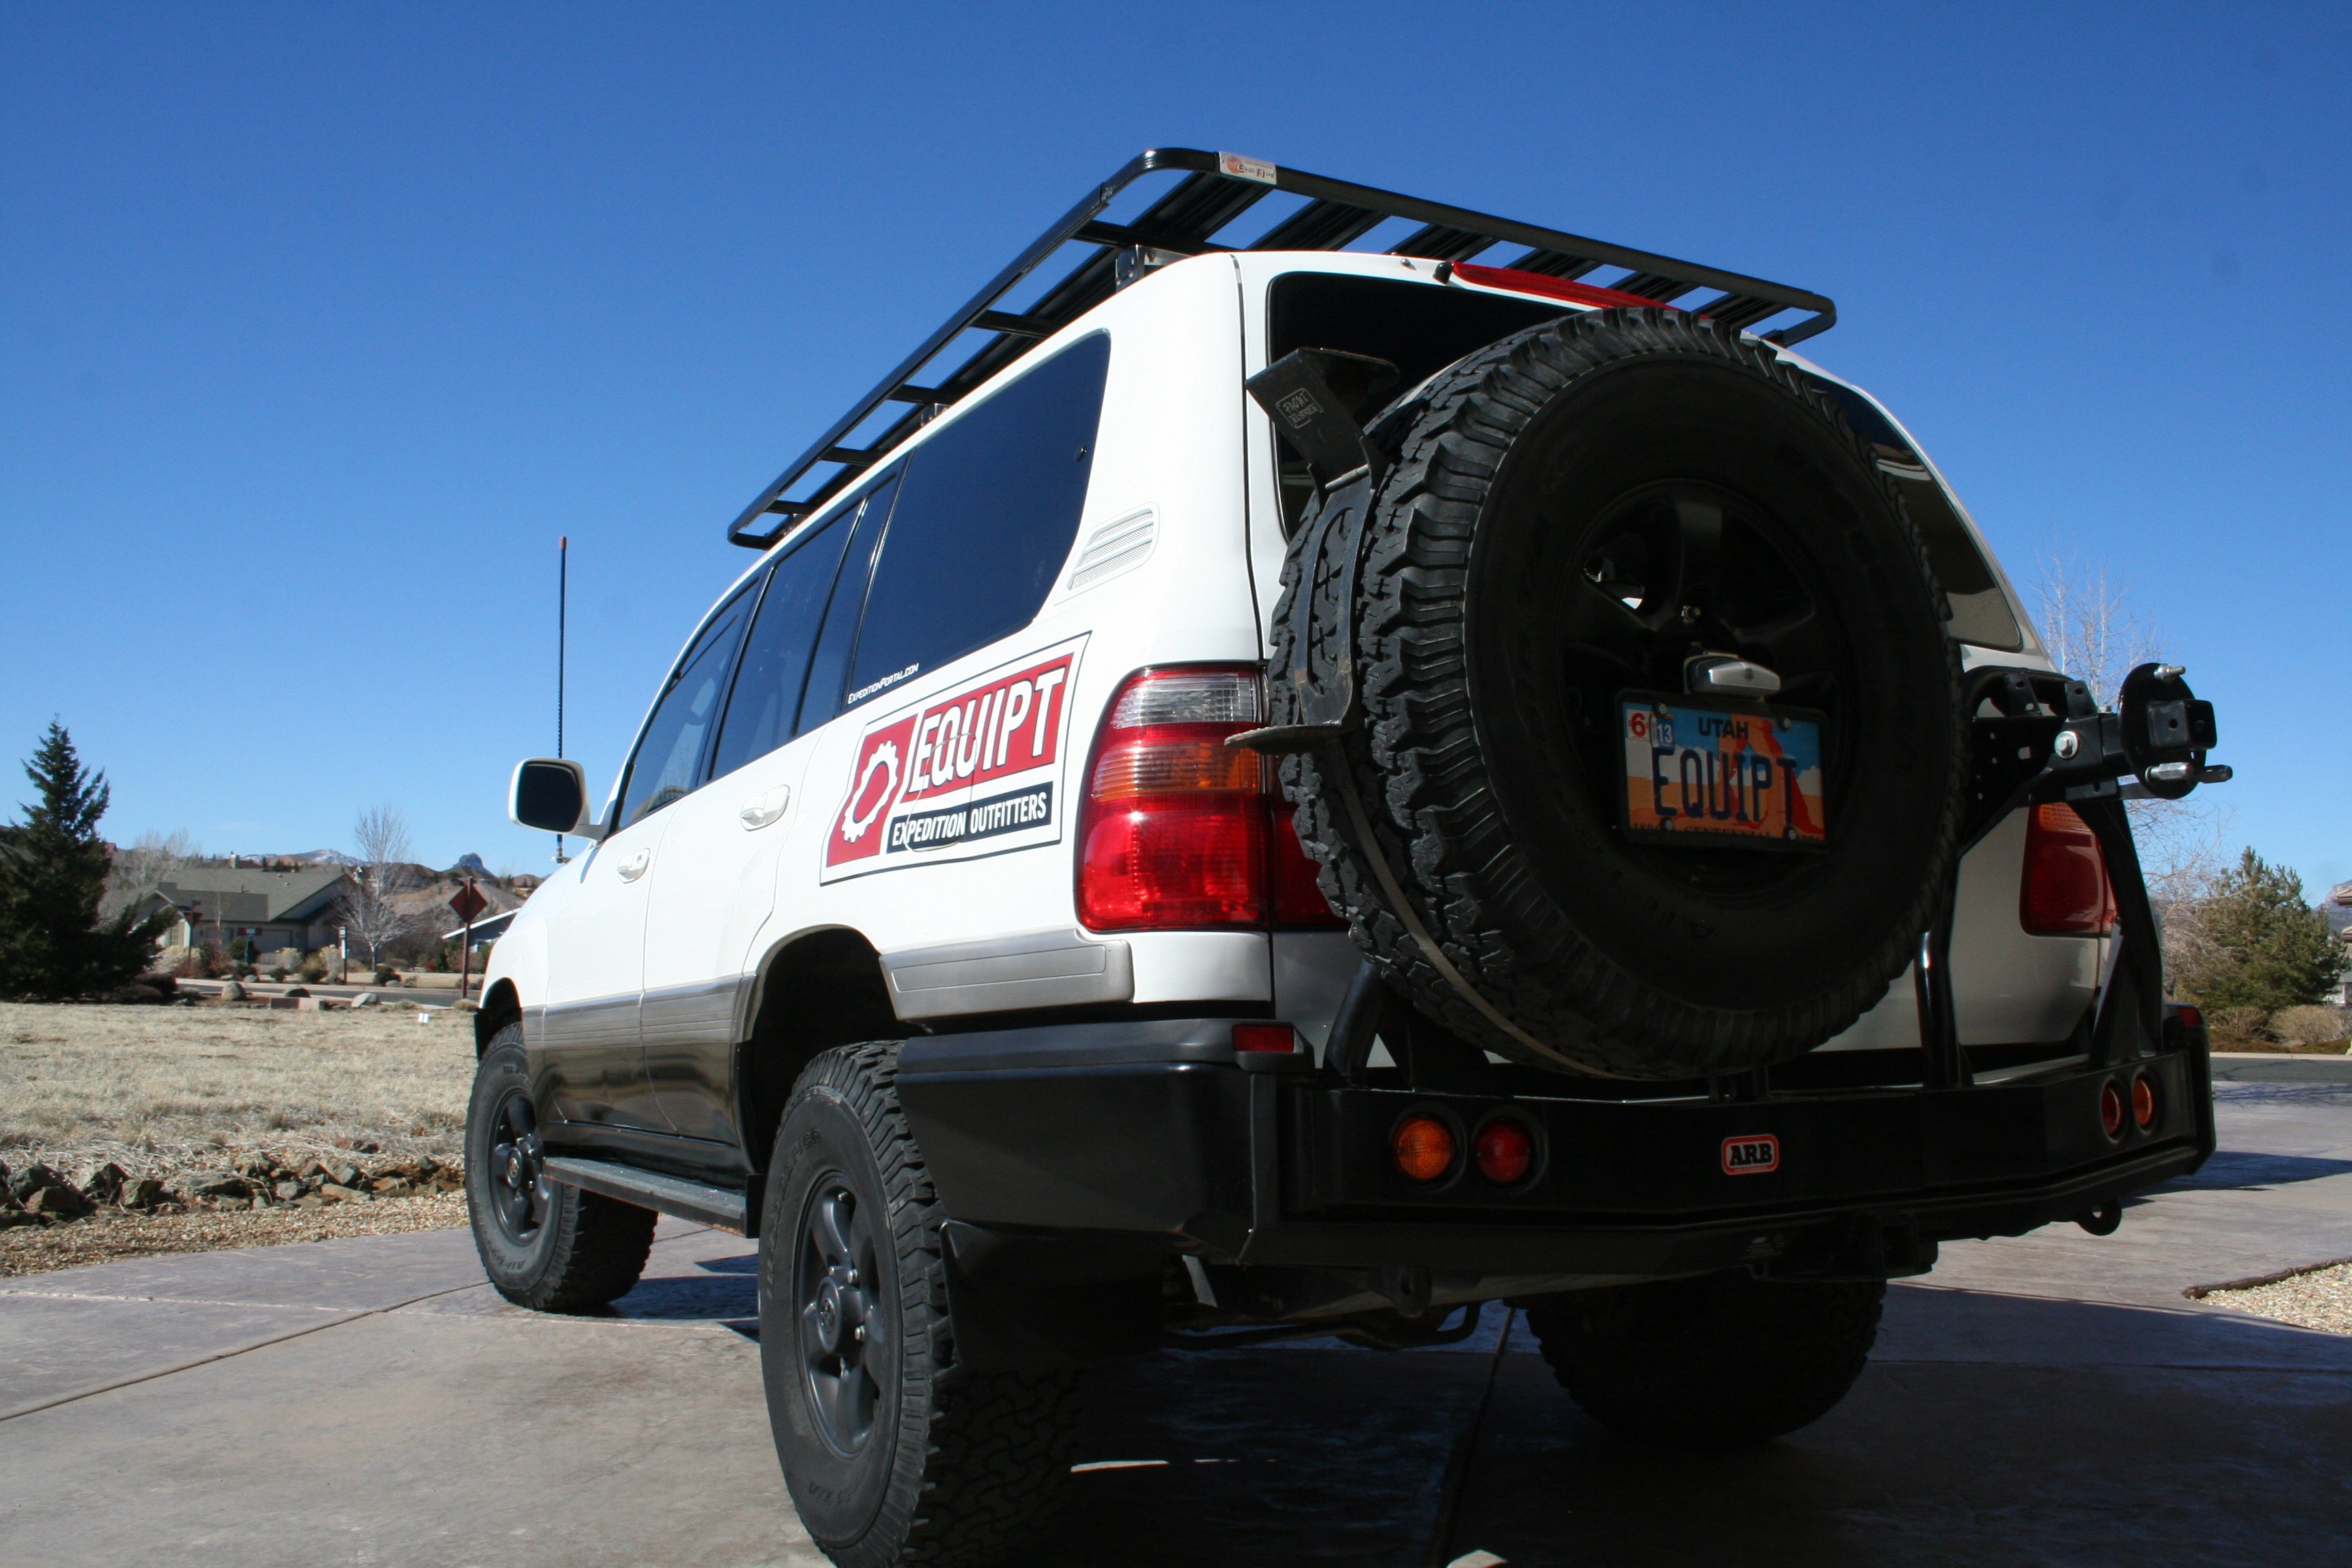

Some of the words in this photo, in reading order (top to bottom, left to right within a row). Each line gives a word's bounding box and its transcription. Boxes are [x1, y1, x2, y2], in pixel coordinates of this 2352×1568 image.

[909, 665, 1067, 795] EQUIPT
[1631, 712, 1646, 738] 6
[1656, 723, 1673, 744] 13
[1698, 717, 1749, 740] UTAH
[1651, 747, 1797, 826] EQUIPT
[892, 811, 966, 847] EXPEDITION
[970, 791, 1047, 834] OUTFITTERS
[1729, 1143, 1772, 1166] ARB
